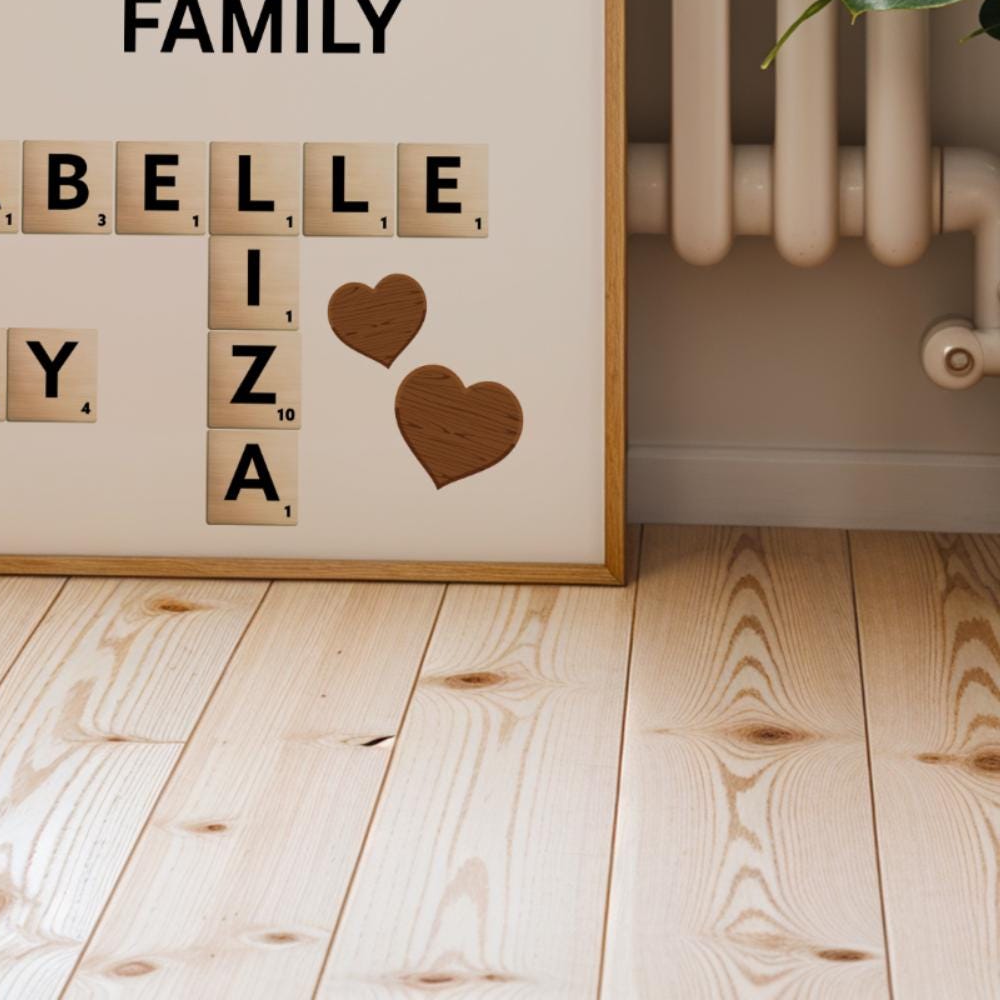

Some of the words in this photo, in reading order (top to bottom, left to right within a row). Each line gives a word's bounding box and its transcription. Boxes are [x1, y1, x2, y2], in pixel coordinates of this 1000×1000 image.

[4, 213, 12, 226] 1
[97, 213, 106, 227] 3
[191, 215, 199, 228] 1
[285, 215, 293, 228] 1
[379, 217, 387, 230] 1
[474, 217, 482, 230] 1
[285, 310, 293, 323] 1
[223, 154, 280, 502] LIZA
[80, 402, 91, 415] 4
[277, 408, 295, 422] 10
[283, 505, 291, 518] 1
